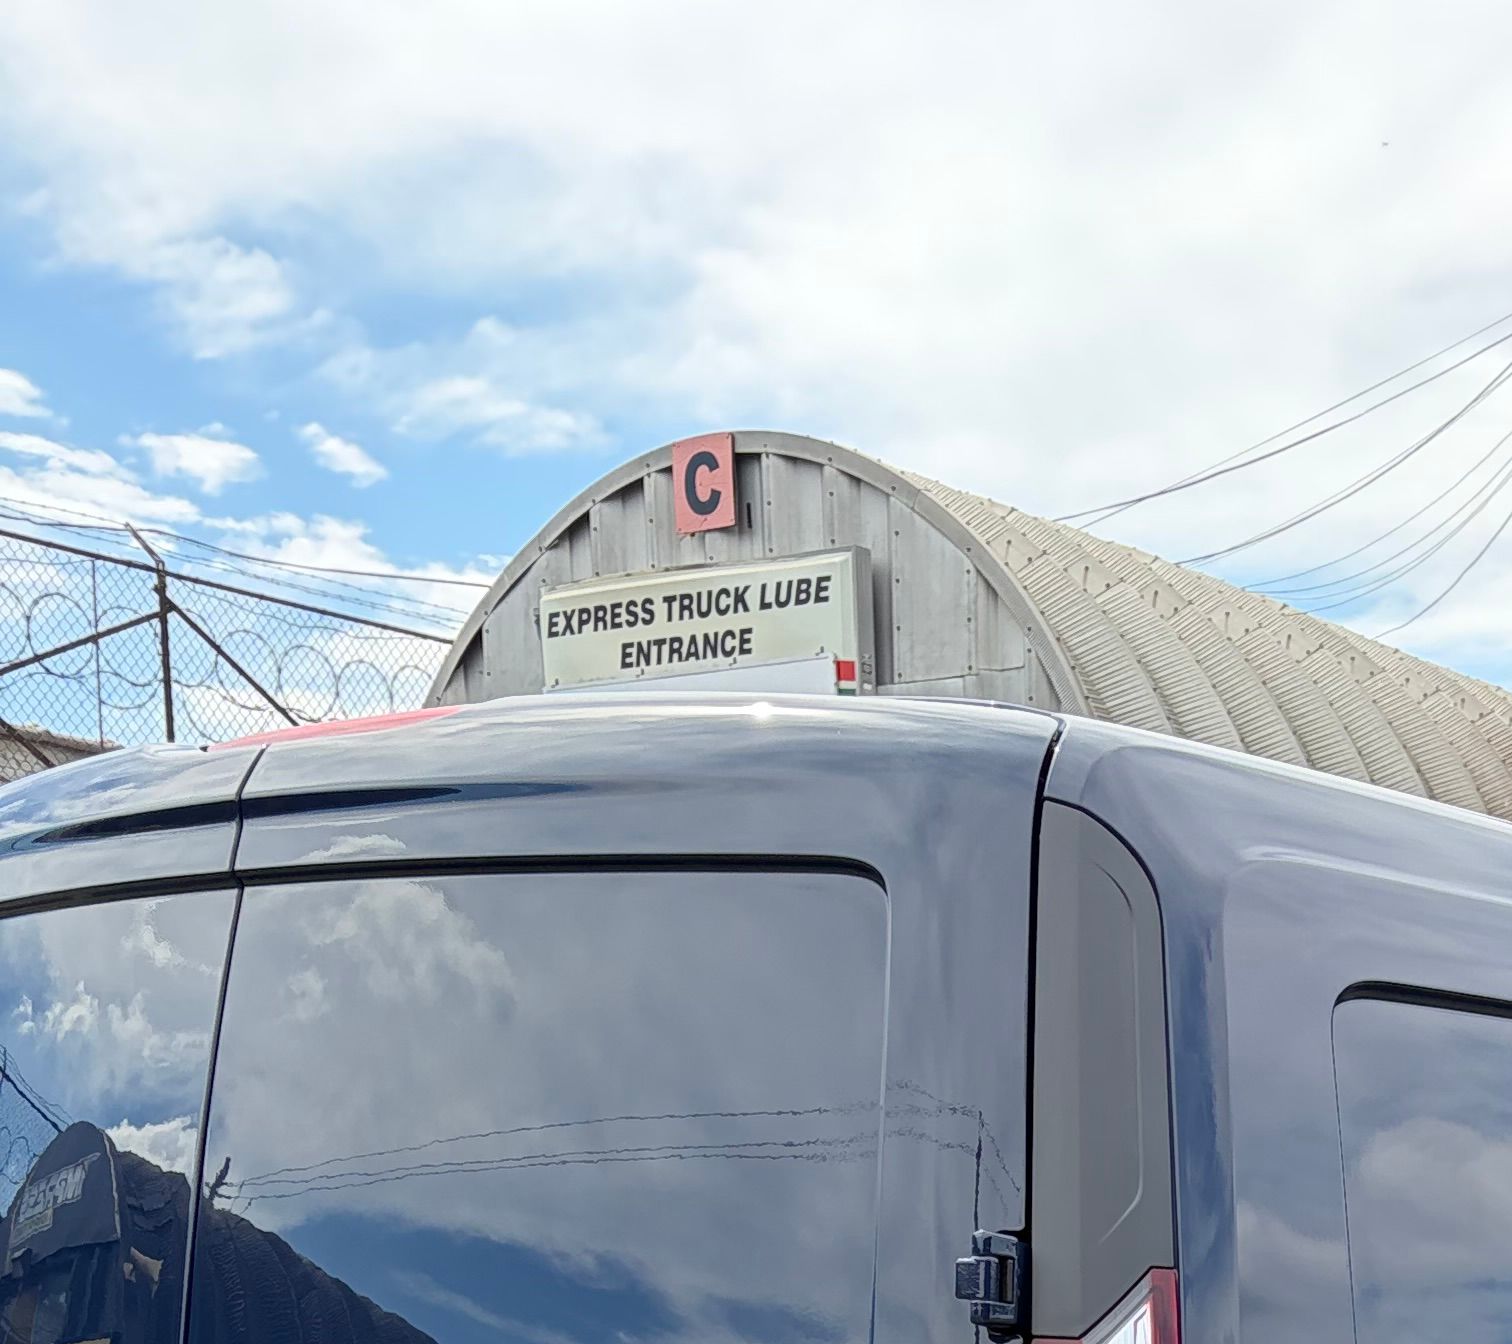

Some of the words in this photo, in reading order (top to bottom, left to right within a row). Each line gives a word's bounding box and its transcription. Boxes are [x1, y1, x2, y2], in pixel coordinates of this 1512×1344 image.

[684, 451, 722, 516] C
[547, 597, 655, 639] EXPRESS
[663, 584, 751, 624] TRUCK
[758, 575, 833, 611] LUBE
[620, 628, 754, 669] ENTRANCE
